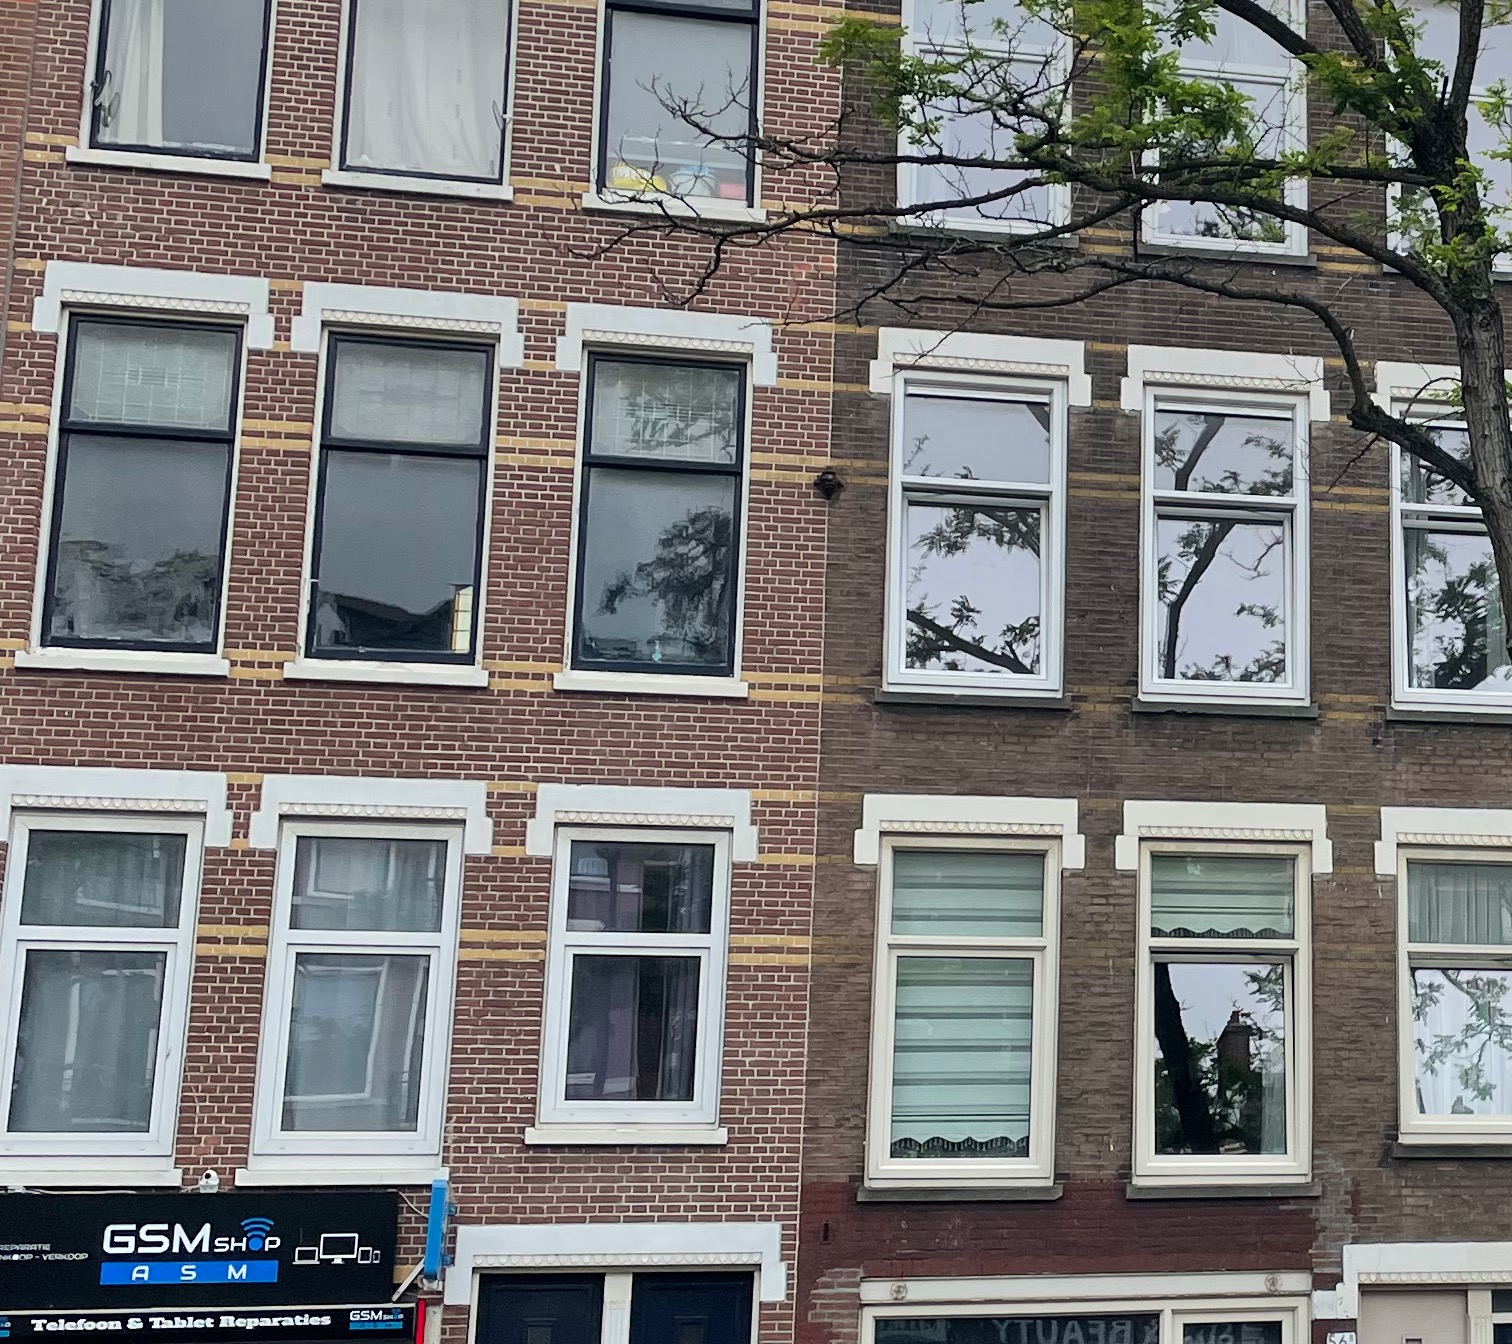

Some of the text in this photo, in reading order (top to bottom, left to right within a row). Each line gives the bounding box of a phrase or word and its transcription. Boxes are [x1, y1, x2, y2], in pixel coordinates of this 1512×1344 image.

[102, 1222, 211, 1254] GSM
[31, 1319, 123, 1332] Telefoon
[127, 1317, 144, 1330] &
[149, 1316, 215, 1330] Tablet
[219, 1313, 332, 1330] Reparaties
